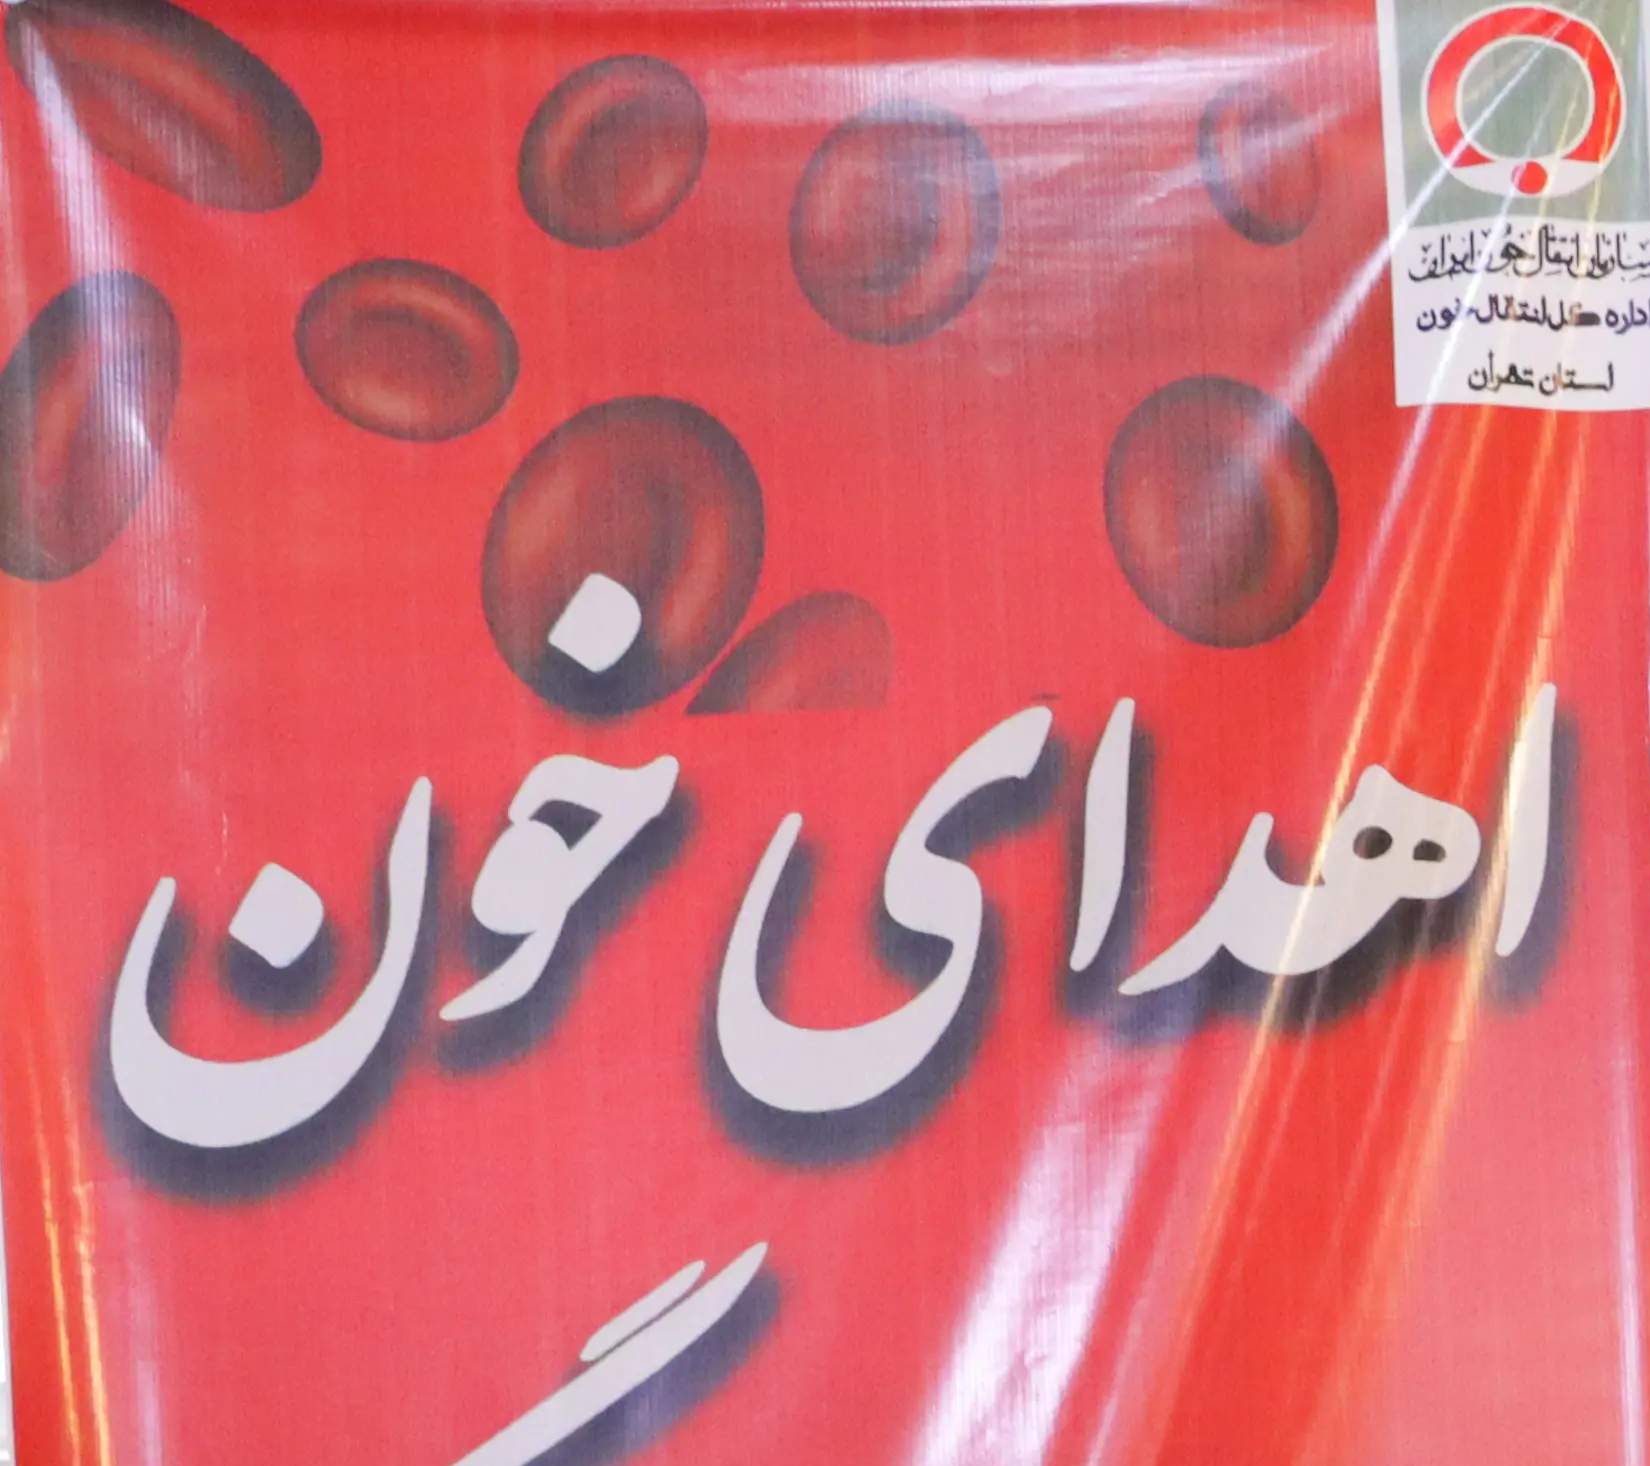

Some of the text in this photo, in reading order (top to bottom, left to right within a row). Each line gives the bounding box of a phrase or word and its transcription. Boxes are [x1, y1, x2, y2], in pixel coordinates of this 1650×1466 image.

[1471, 293, 1547, 324] انتقال
[1548, 299, 1600, 331] کل
[1468, 348, 1614, 394] استان تهران
[110, 574, 1554, 1147] اهدای خون
